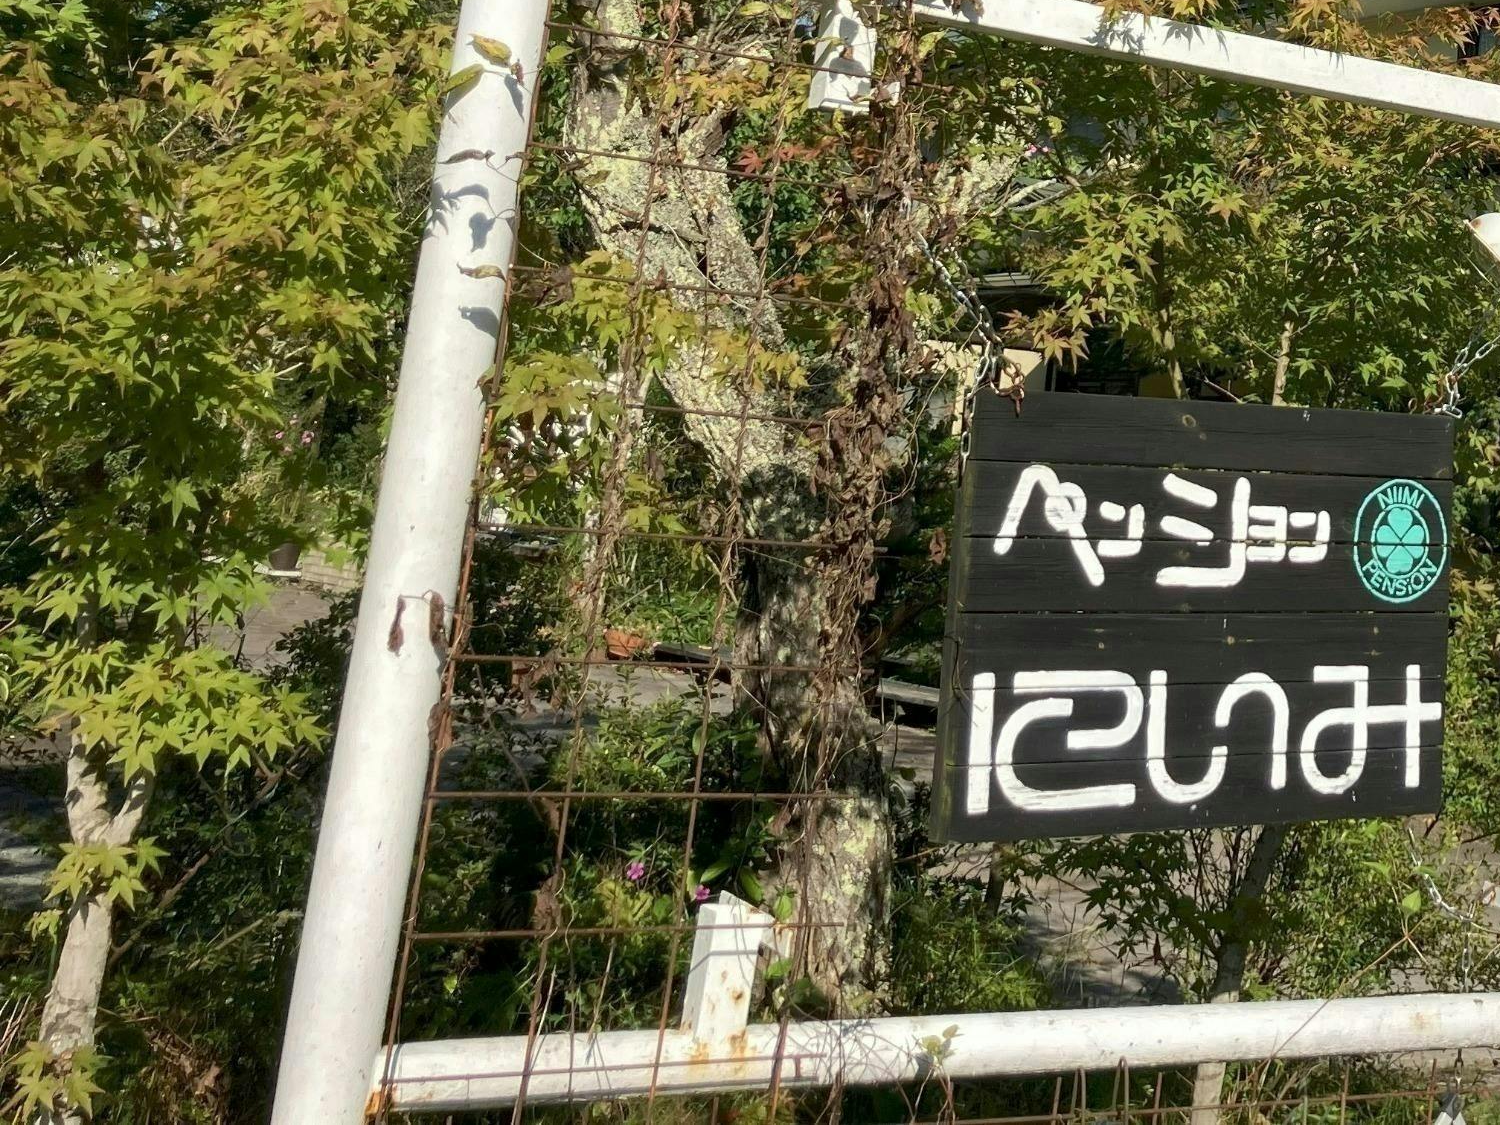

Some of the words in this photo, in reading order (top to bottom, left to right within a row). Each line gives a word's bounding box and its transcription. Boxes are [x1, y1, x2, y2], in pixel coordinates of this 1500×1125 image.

[993, 464, 1331, 587] ペンション
[1377, 486, 1426, 510] NIIMI
